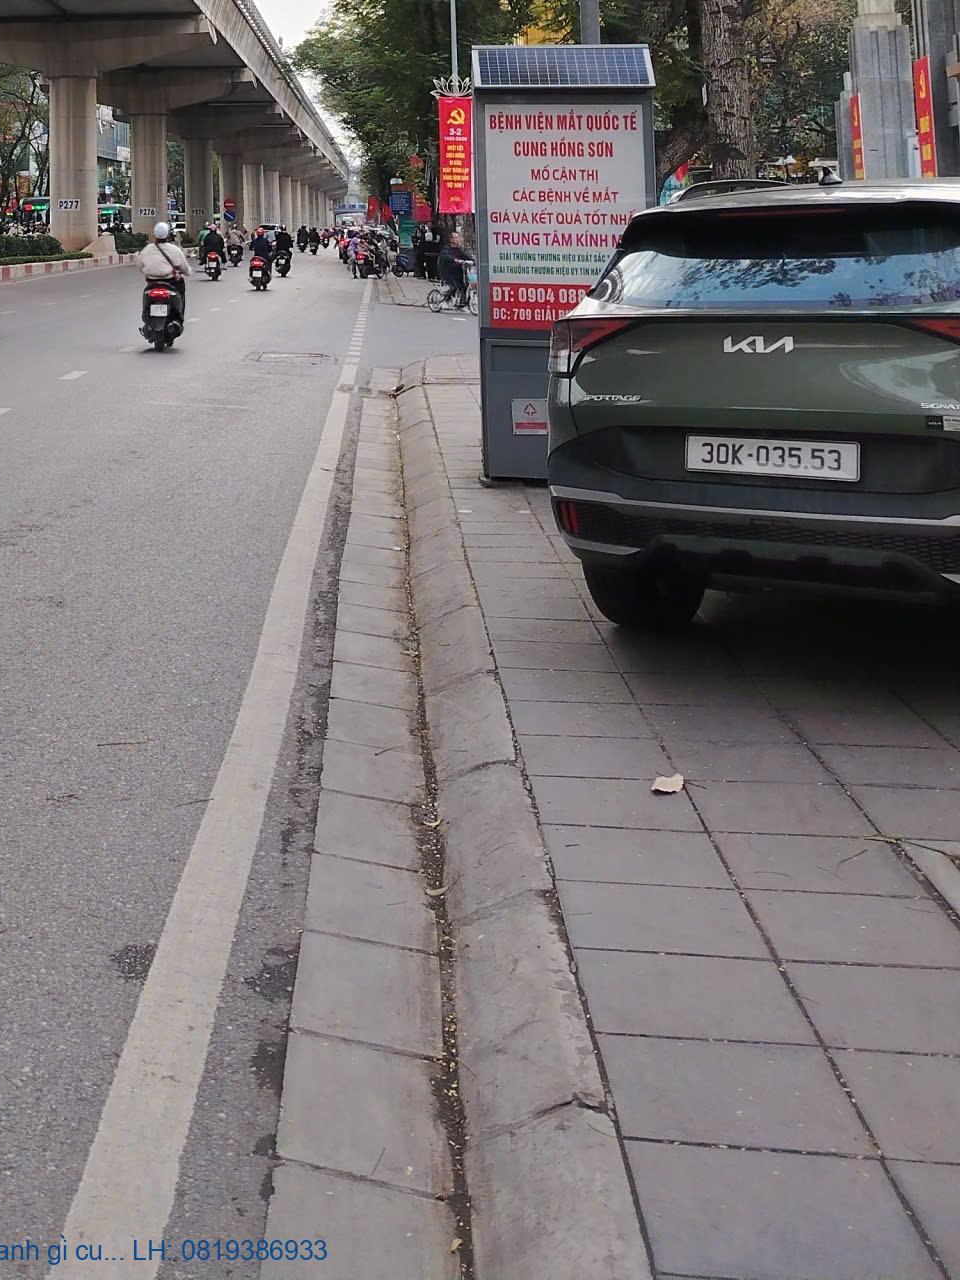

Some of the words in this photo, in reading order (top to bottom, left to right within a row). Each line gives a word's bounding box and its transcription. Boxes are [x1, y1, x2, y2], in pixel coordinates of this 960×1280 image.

[489, 111, 522, 133] BỆNH
[525, 111, 553, 133] VIỆN
[556, 109, 583, 131] MẮT
[586, 109, 620, 132] QUỐC
[623, 109, 638, 131] TẾ
[514, 141, 547, 157] CUNG
[588, 140, 614, 157] SƠN
[552, 167, 577, 183] CẬN
[579, 169, 599, 184] THỊ
[512, 187, 536, 202] CÁC
[538, 188, 572, 205] BỆNH
[592, 186, 619, 204] MẮT
[58, 200, 79, 211] P277
[139, 208, 155, 216] P276
[512, 208, 529, 224] VÀ
[531, 207, 554, 225] KẾT
[584, 208, 608, 226] TỐT
[610, 209, 636, 226] NHẤ
[493, 231, 540, 246] TRUNG
[543, 230, 573, 247] TÂM
[576, 230, 608, 248] KÍNH
[492, 286, 515, 302] ĐT:
[518, 287, 555, 303] 0904
[492, 307, 510, 320] ĐC:
[512, 308, 532, 320] 709
[723, 335, 794, 354] KIA
[700, 442, 842, 471] 30K-035.53
